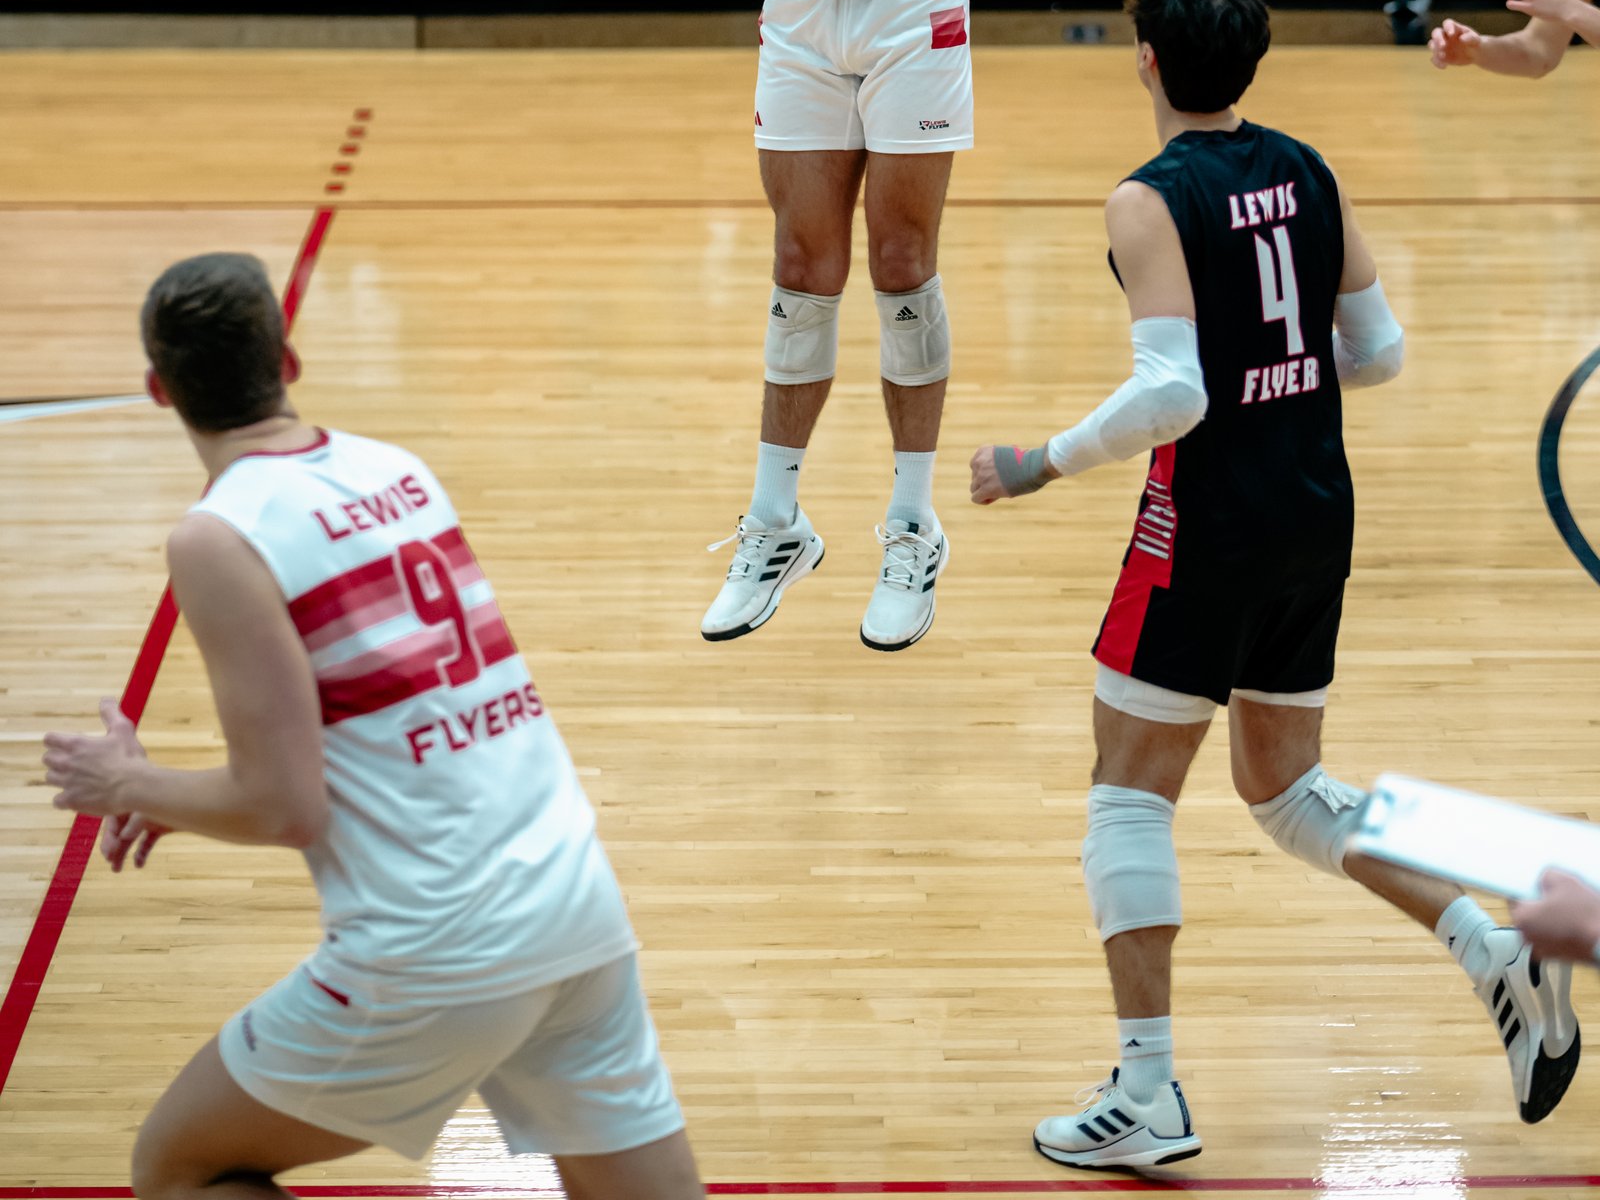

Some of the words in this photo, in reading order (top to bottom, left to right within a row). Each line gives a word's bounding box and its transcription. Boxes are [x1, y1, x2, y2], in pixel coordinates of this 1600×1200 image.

[1228, 181, 1298, 230] LEWIS
[1254, 224, 1305, 356] 4
[312, 474, 430, 542] LEWIS
[394, 539, 485, 689] 9
[404, 682, 545, 766] FLYERS
